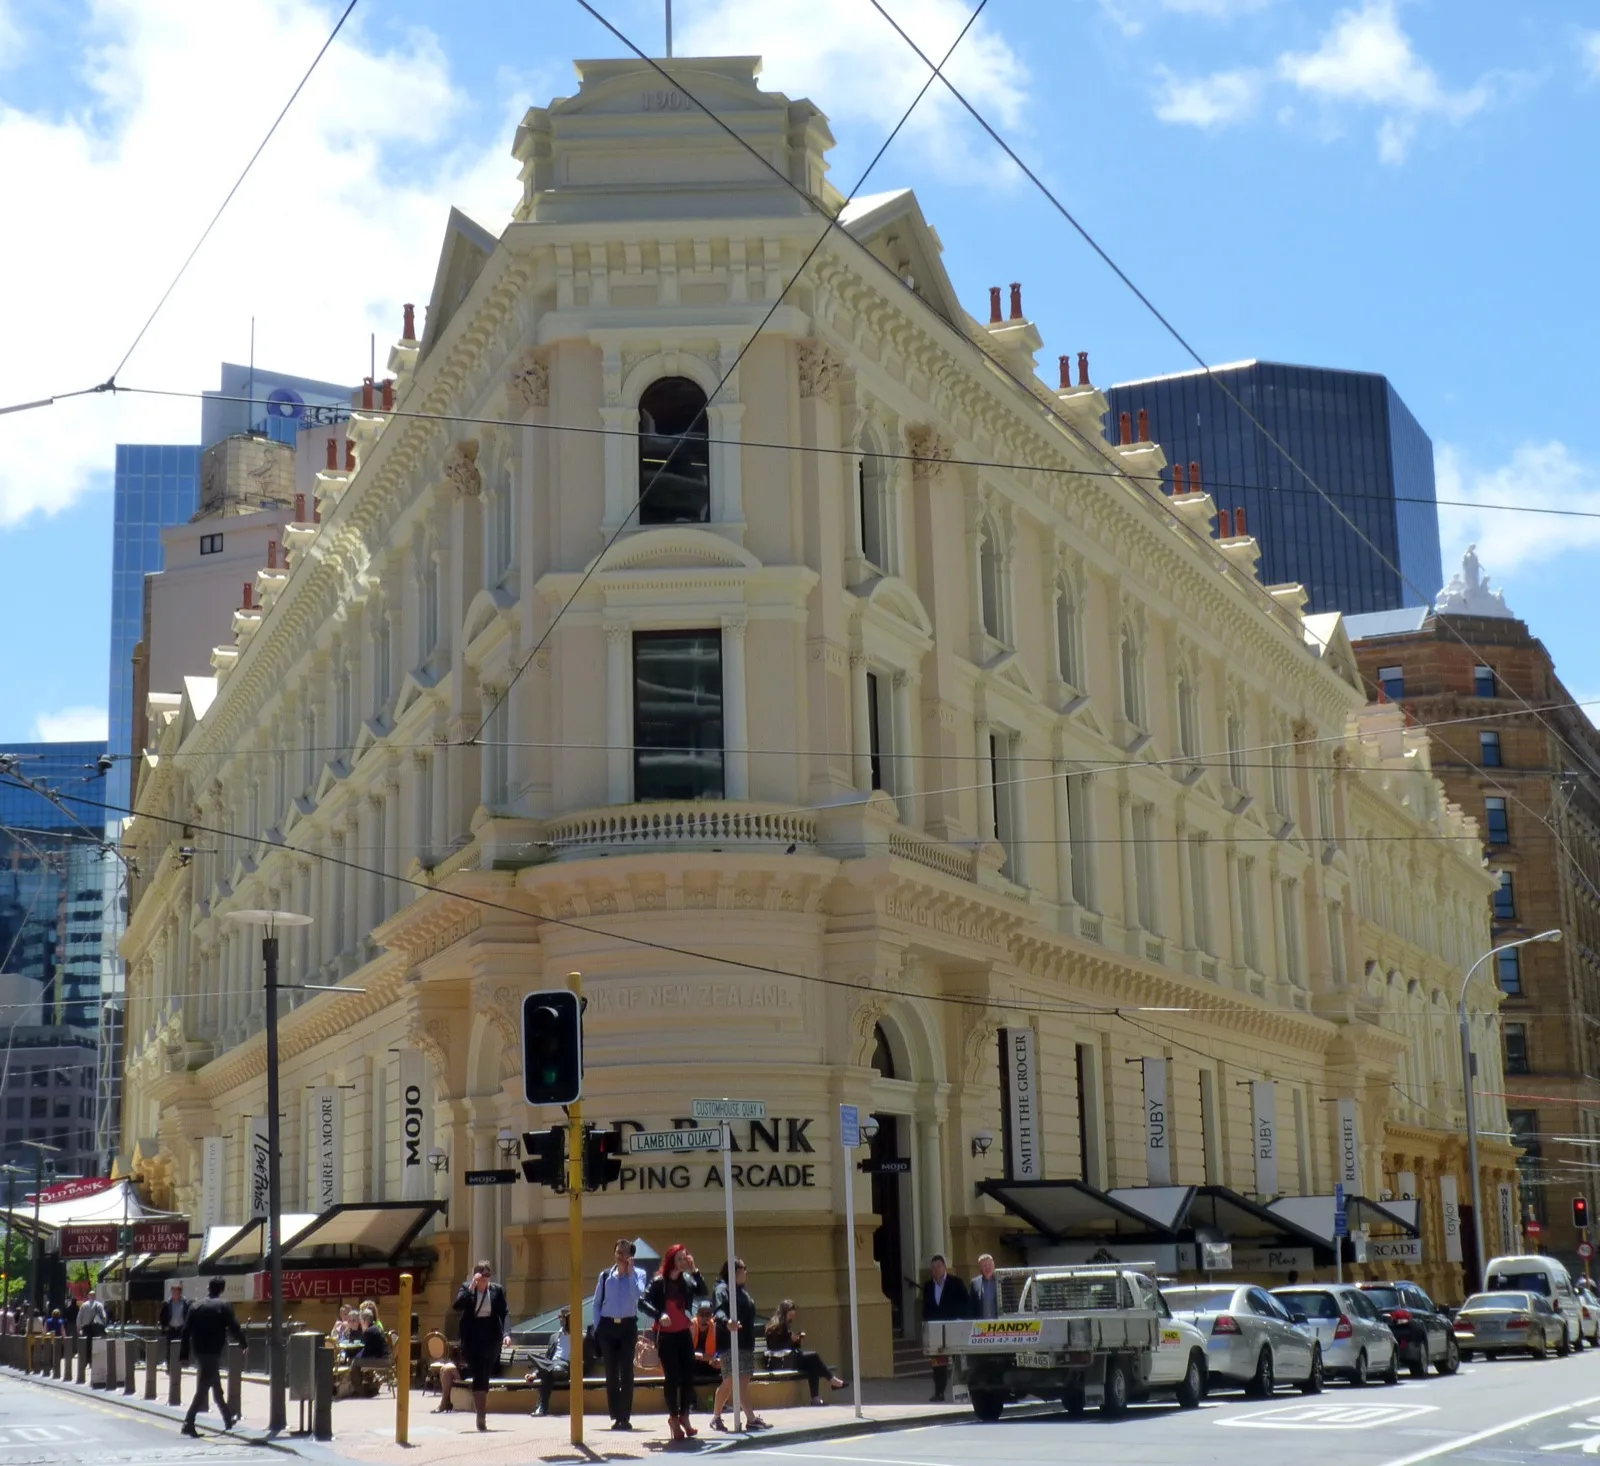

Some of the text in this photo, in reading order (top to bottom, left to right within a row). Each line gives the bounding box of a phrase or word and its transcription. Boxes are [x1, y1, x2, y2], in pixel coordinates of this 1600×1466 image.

[648, 984, 692, 1009] NEW
[696, 1101, 758, 1118] CUSTOMHOUSE QUAY
[1015, 1034, 1033, 1174] SMITH THE GROCER
[321, 1096, 333, 1146] MOORE
[405, 1085, 423, 1168] MOJO
[1149, 1099, 1164, 1149] RUBY
[637, 1133, 684, 1151] LAMBTON
[687, 1131, 714, 1148] QUAY
[1259, 1117, 1272, 1159] RUBY
[1343, 1117, 1355, 1181] RICOCHET
[703, 1164, 816, 1189] ARCADE
[881, 1163, 908, 1171] MOJO
[468, 1176, 497, 1184] MOJO
[39, 1180, 105, 1203] OLD BANK
[151, 1225, 171, 1234] THE
[1445, 1202, 1456, 1236] taylor
[77, 1235, 99, 1244] BNZ
[134, 1232, 186, 1243] OLD BANK
[68, 1243, 110, 1254] CENTRE
[1373, 1243, 1418, 1257] RCADE
[987, 1322, 1033, 1332] HANDY
